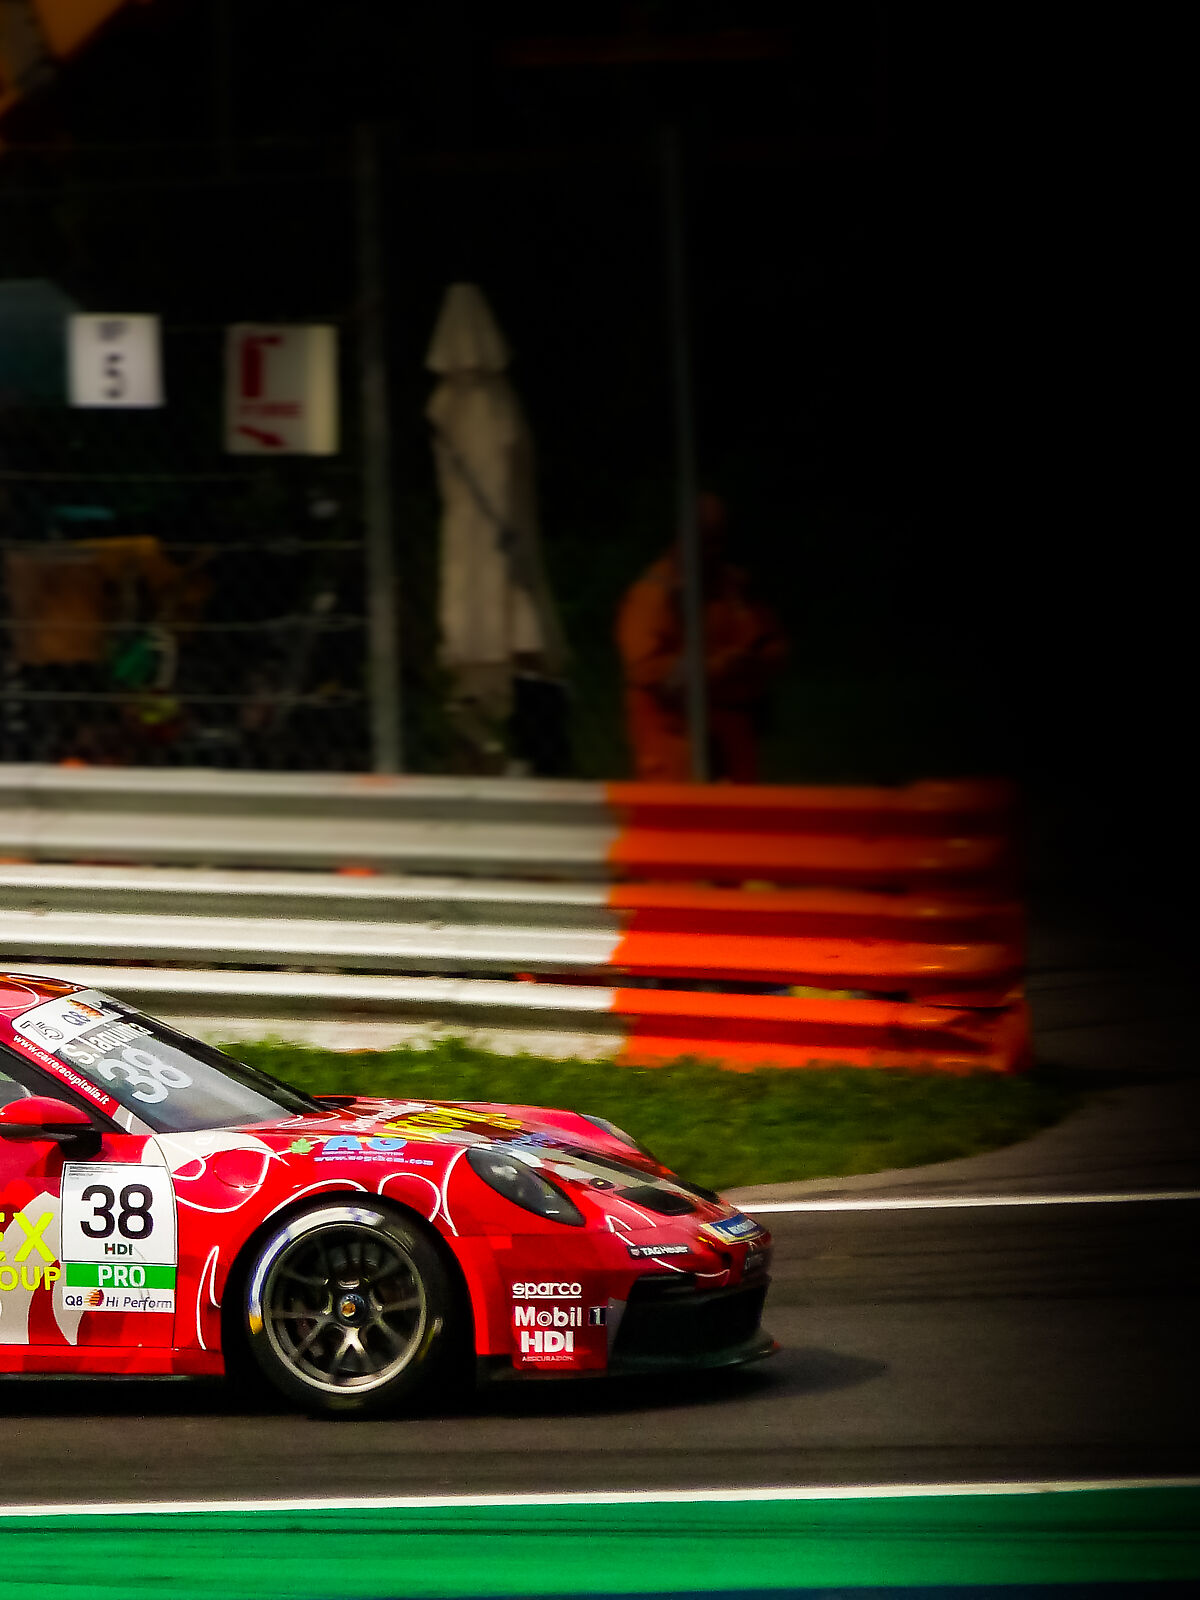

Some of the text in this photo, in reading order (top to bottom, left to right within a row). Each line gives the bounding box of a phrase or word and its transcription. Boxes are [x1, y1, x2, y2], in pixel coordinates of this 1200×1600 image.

[97, 1049, 194, 1104] 38
[80, 1183, 154, 1240] 38
[104, 1243, 133, 1256] HDI
[98, 1265, 146, 1288] PRO
[512, 1282, 582, 1299] sparco
[65, 1295, 173, 1311] Q8 Hi Perform
[515, 1305, 582, 1327] Mobil
[521, 1331, 574, 1353] HDI
